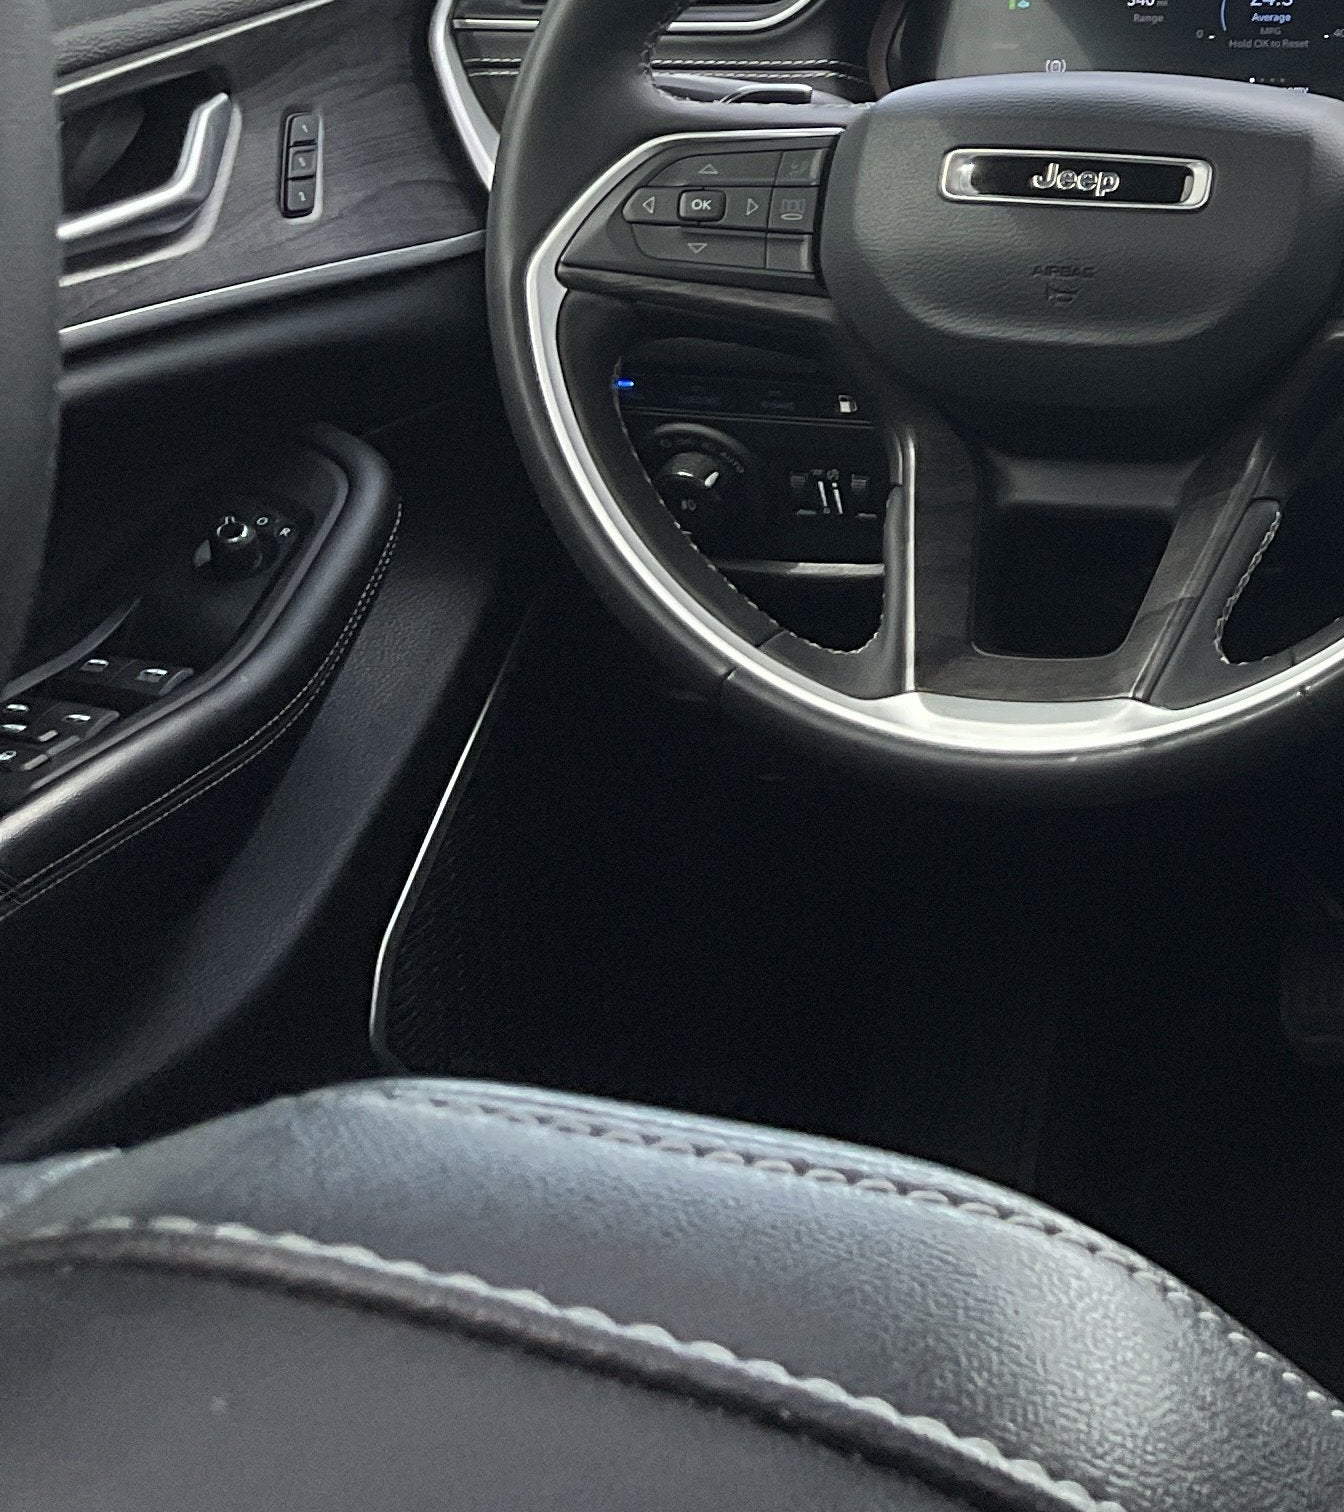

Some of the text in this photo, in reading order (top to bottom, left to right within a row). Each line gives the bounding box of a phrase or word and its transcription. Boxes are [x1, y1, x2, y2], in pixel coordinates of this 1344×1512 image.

[1133, 13, 1164, 24] Range
[1251, 12, 1292, 24] Average
[1032, 162, 1120, 197] Jeep
[691, 198, 712, 211] OK
